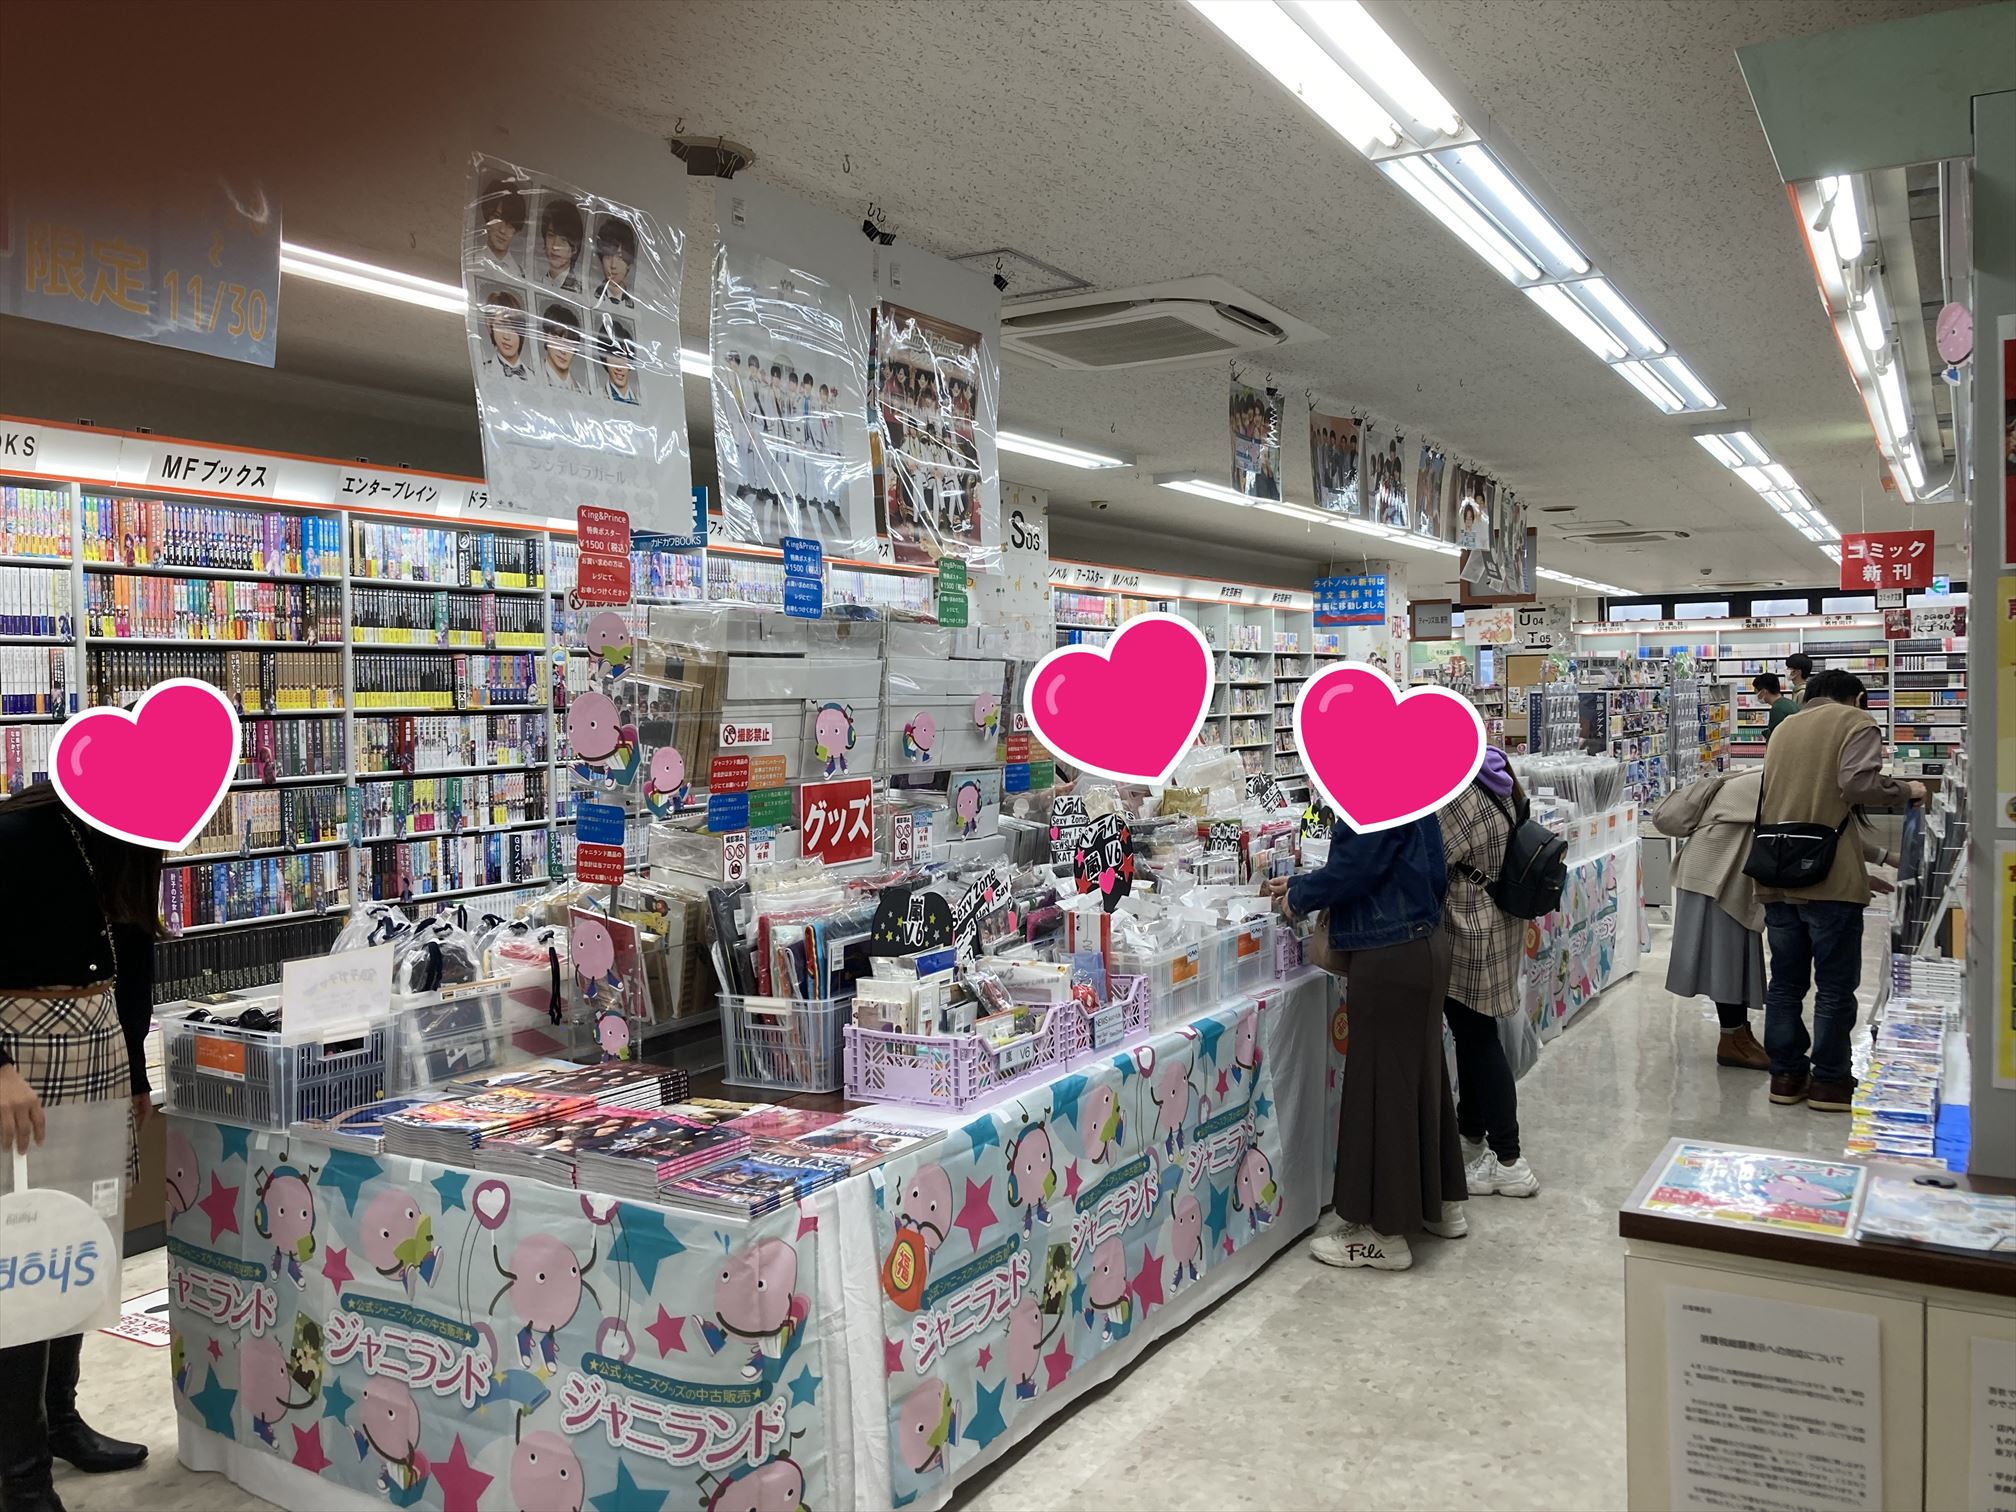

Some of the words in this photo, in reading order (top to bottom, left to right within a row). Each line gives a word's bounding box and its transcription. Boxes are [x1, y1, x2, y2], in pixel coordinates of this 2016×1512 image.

[26, 221, 149, 316] 限定
[163, 270, 267, 342] 11/30
[0, 433, 36, 457] KS
[161, 454, 268, 488] MFブックス
[342, 476, 438, 503] エンターブレイン
[581, 509, 627, 523] King&Prince
[651, 535, 702, 548] カドカワBOOKS
[785, 540, 820, 551] King&Prince
[1847, 540, 1926, 559] コミック
[1313, 577, 1385, 587] ライトノベル新刊は
[1862, 562, 1912, 582] 新刊
[1532, 617, 1543, 626] 04
[1540, 634, 1551, 643] 05
[737, 728, 770, 743] 撮影禁止
[804, 794, 870, 851] グッズ
[1052, 816, 1067, 825] Sexy
[1106, 842, 1121, 865] V6
[1085, 852, 1100, 880] 嵐
[909, 895, 925, 923] 嵐
[951, 895, 973, 928] Sexy
[972, 868, 996, 900] Zone
[902, 923, 924, 947] V6
[1019, 1045, 1032, 1060] V6
[1072, 1173, 1158, 1263] ジャニランド
[1345, 1243, 1386, 1261] Fila
[171, 1268, 276, 1334] ャニランド
[914, 1255, 1027, 1367] ジャニランド
[327, 1314, 487, 1402] ジャニランド
[563, 1377, 783, 1466] ジャニランド
